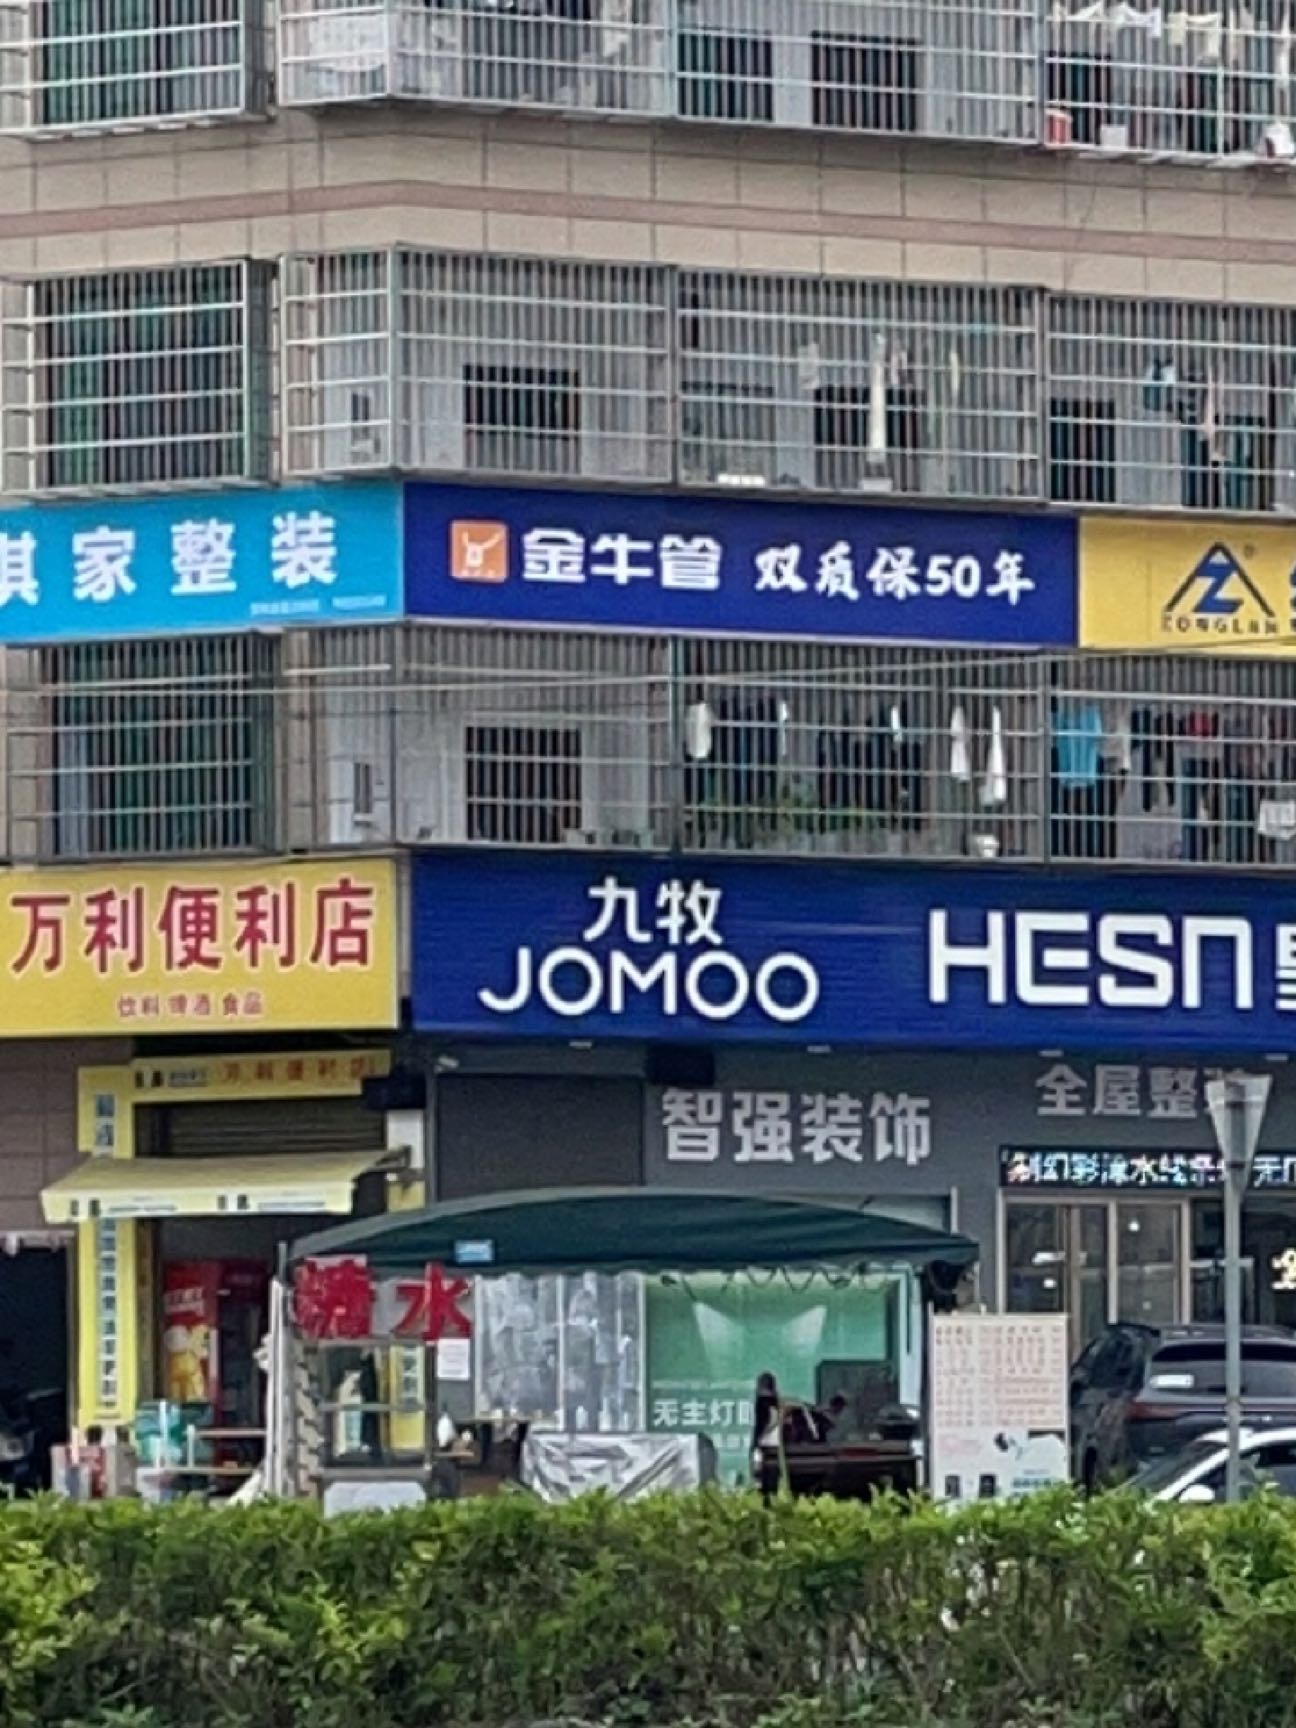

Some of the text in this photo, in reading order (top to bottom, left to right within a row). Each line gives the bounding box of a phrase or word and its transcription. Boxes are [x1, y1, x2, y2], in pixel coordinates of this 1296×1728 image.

[522, 527, 1036, 605] 金牛管 双质保50年
[10, 877, 375, 973] 万利便利店
[582, 876, 724, 946] 九牧
[478, 947, 821, 1023] JOMOO
[661, 1087, 933, 1166] 智强装饰
[1035, 1063, 1248, 1119] 全屋整
[293, 1258, 474, 1342] 糖水
